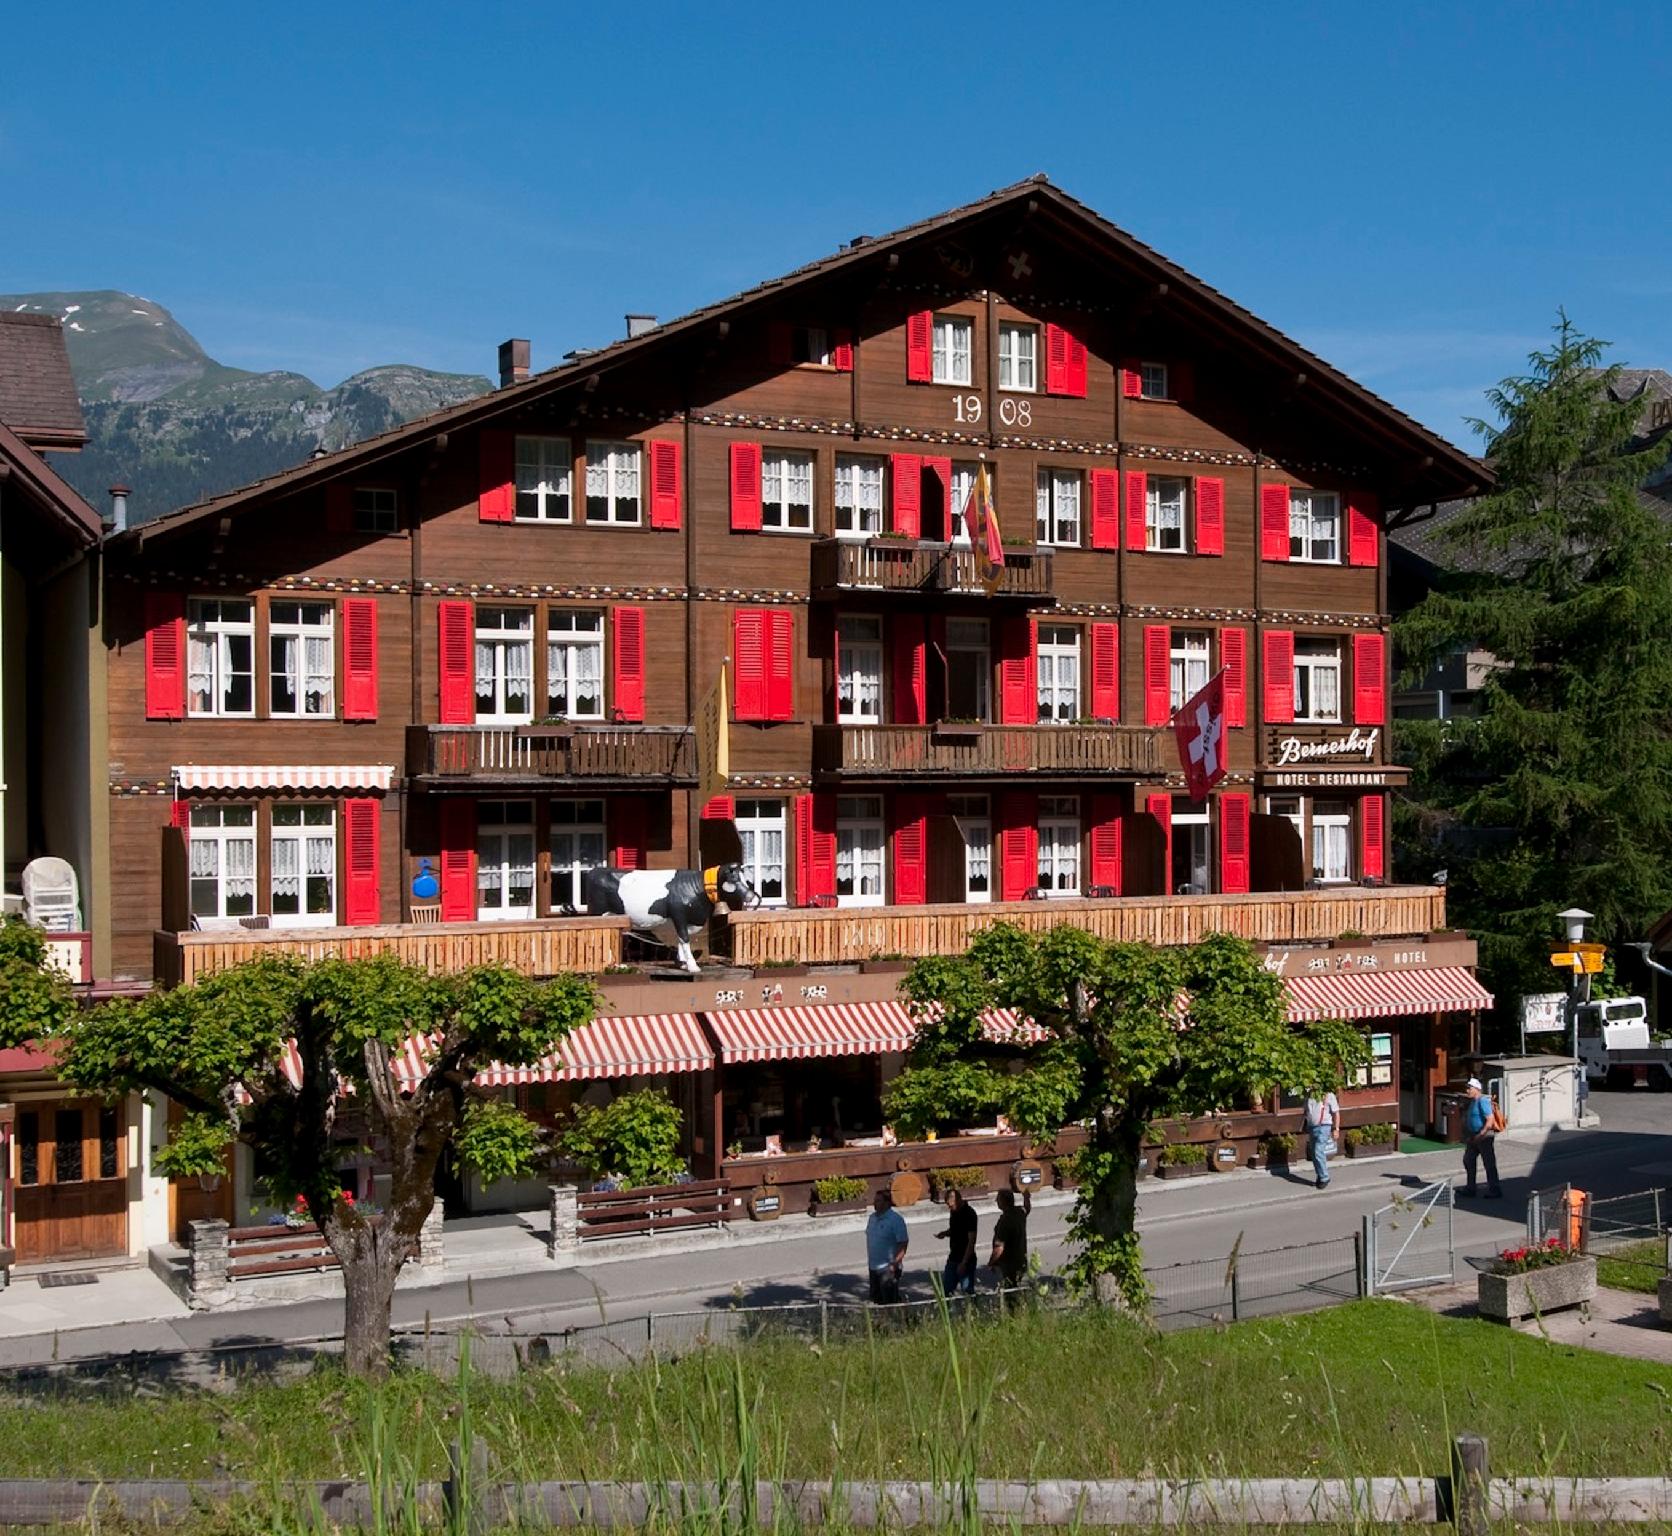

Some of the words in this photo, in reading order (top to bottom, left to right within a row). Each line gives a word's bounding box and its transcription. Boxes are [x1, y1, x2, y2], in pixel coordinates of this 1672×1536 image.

[952, 395, 982, 423] 19
[1000, 398, 1032, 427] 08
[1276, 773, 1310, 786] HOTEL
[1319, 773, 1386, 786] RESTAURANT
[1394, 950, 1428, 964] HOTEL
